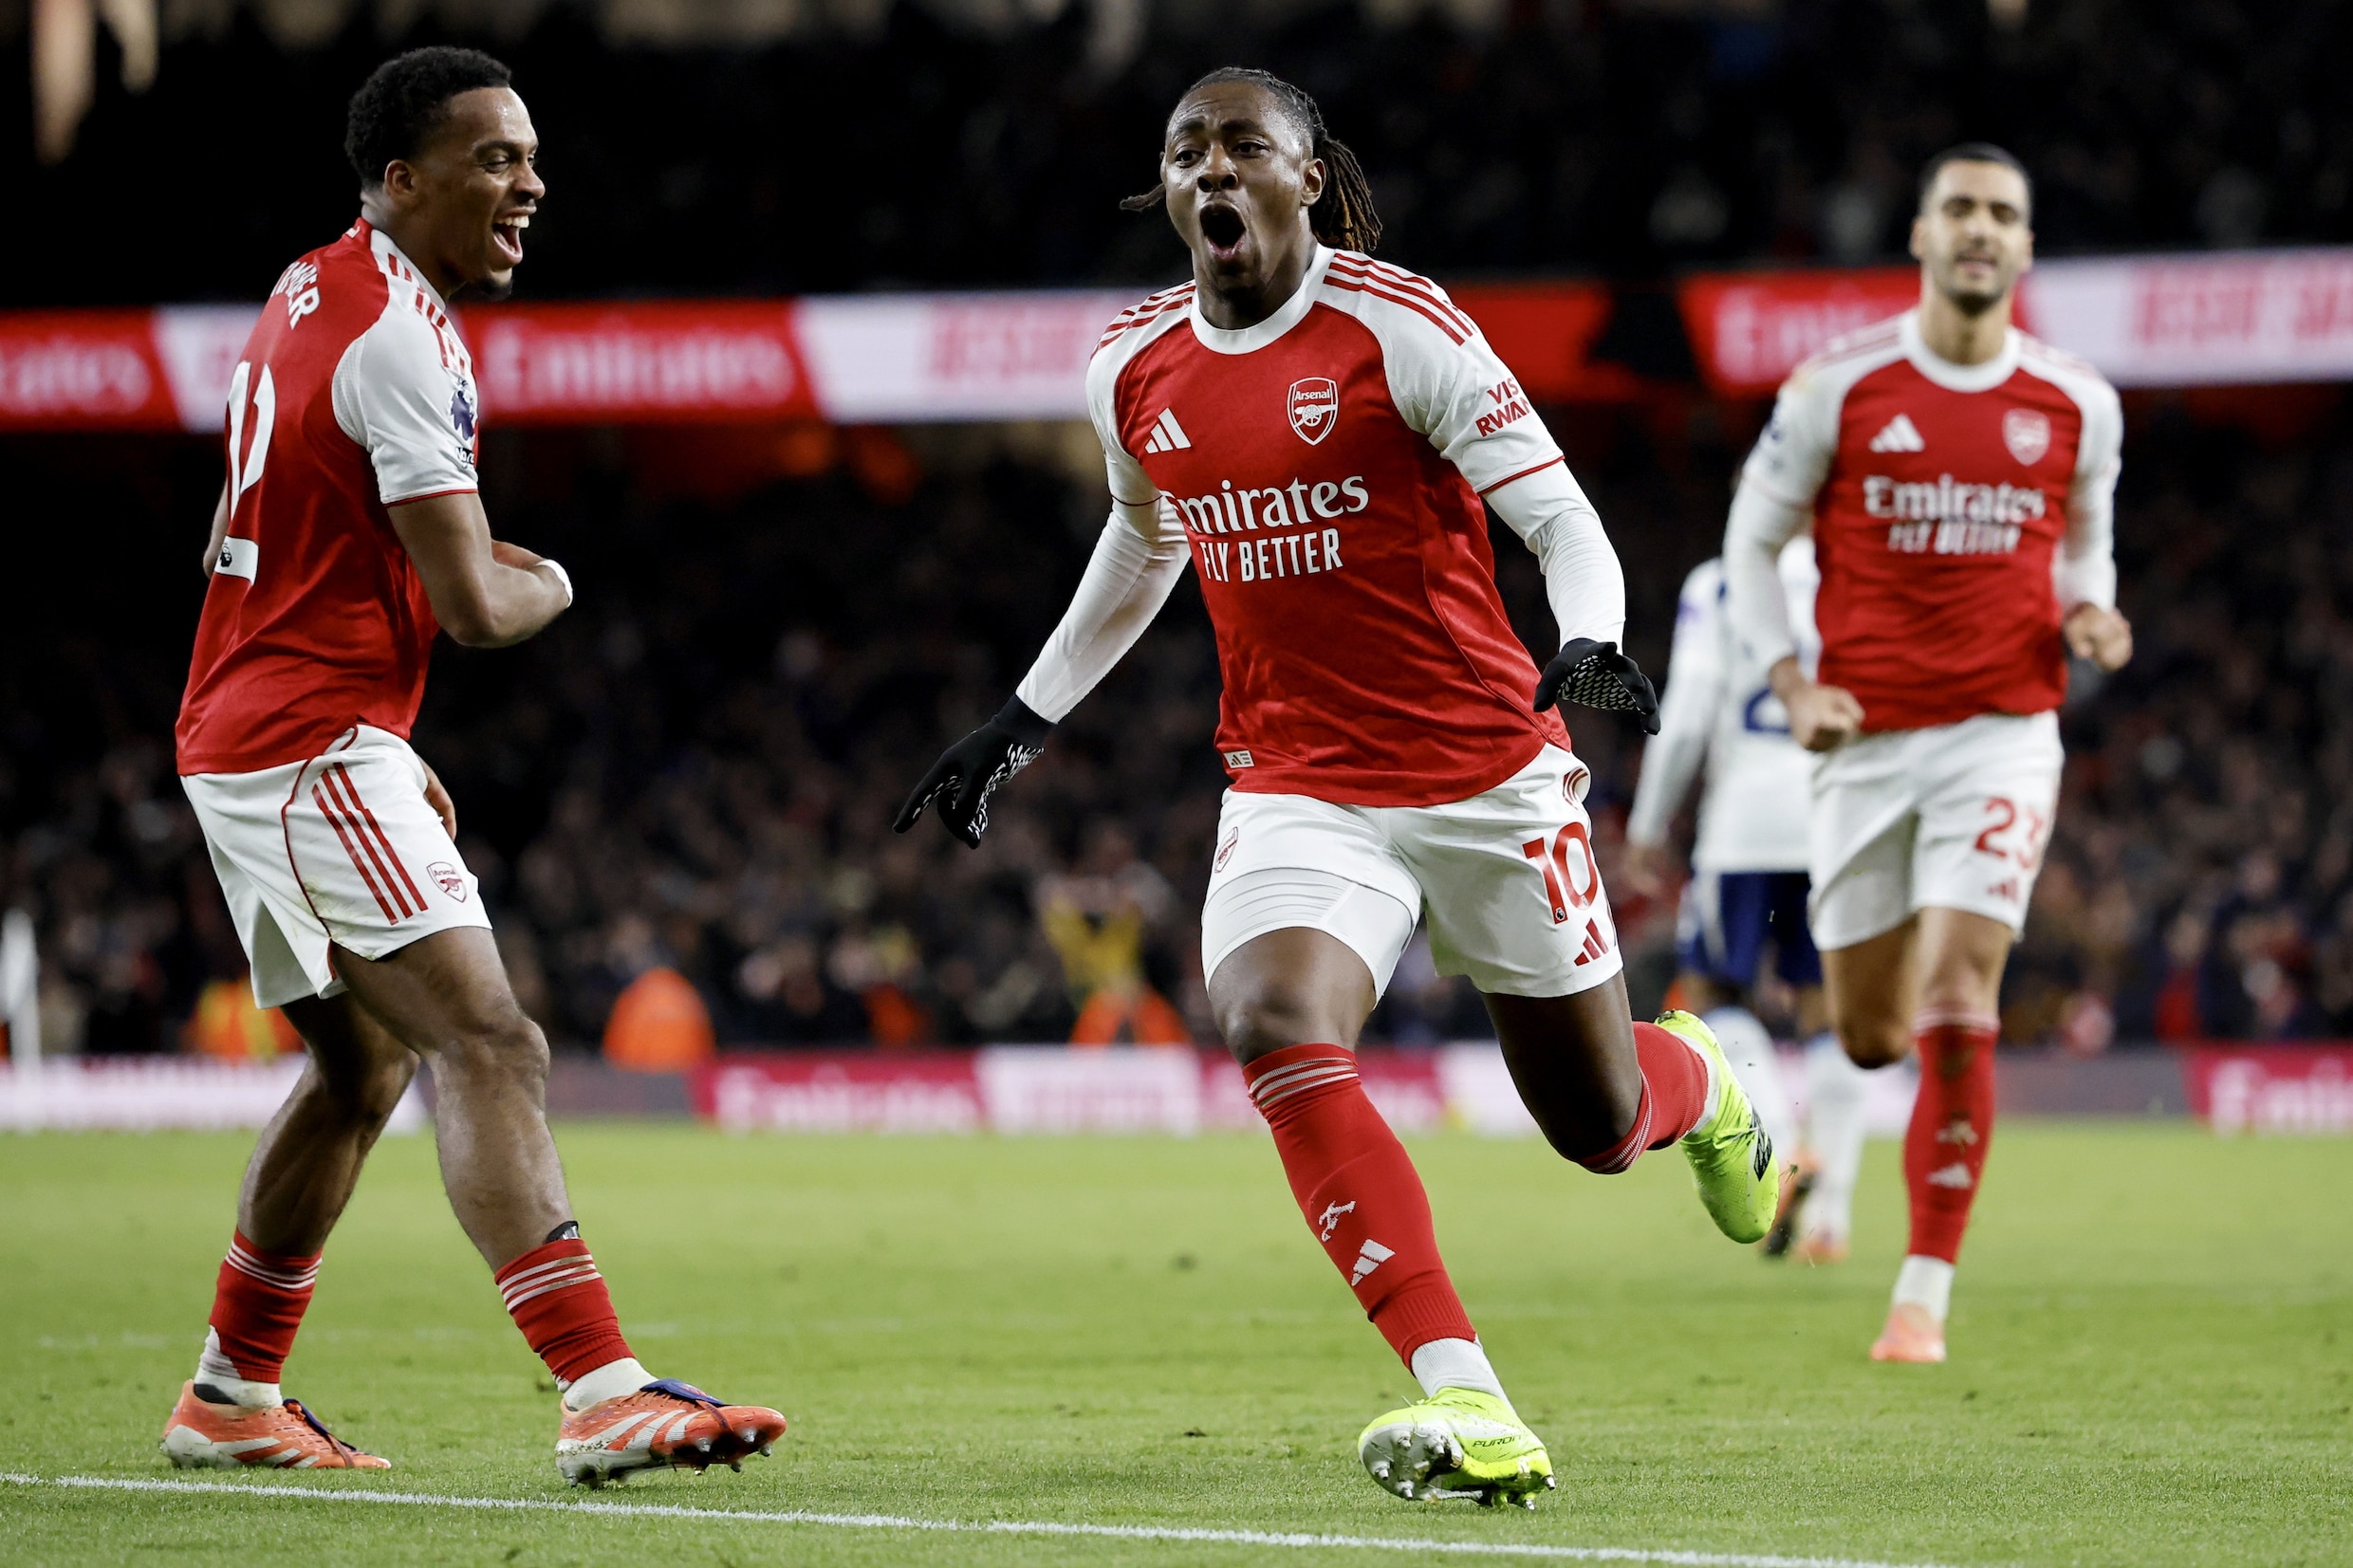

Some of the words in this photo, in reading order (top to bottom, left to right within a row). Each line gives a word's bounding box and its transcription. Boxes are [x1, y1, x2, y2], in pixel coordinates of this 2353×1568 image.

[1294, 388, 1331, 401] Arsenal
[1487, 376, 1519, 405] VIS
[1176, 475, 1369, 534] mirates
[1862, 472, 2046, 523] Emirates
[1199, 541, 1230, 582] FLY
[1238, 527, 1343, 582] BETTER
[1523, 821, 1598, 925] 10
